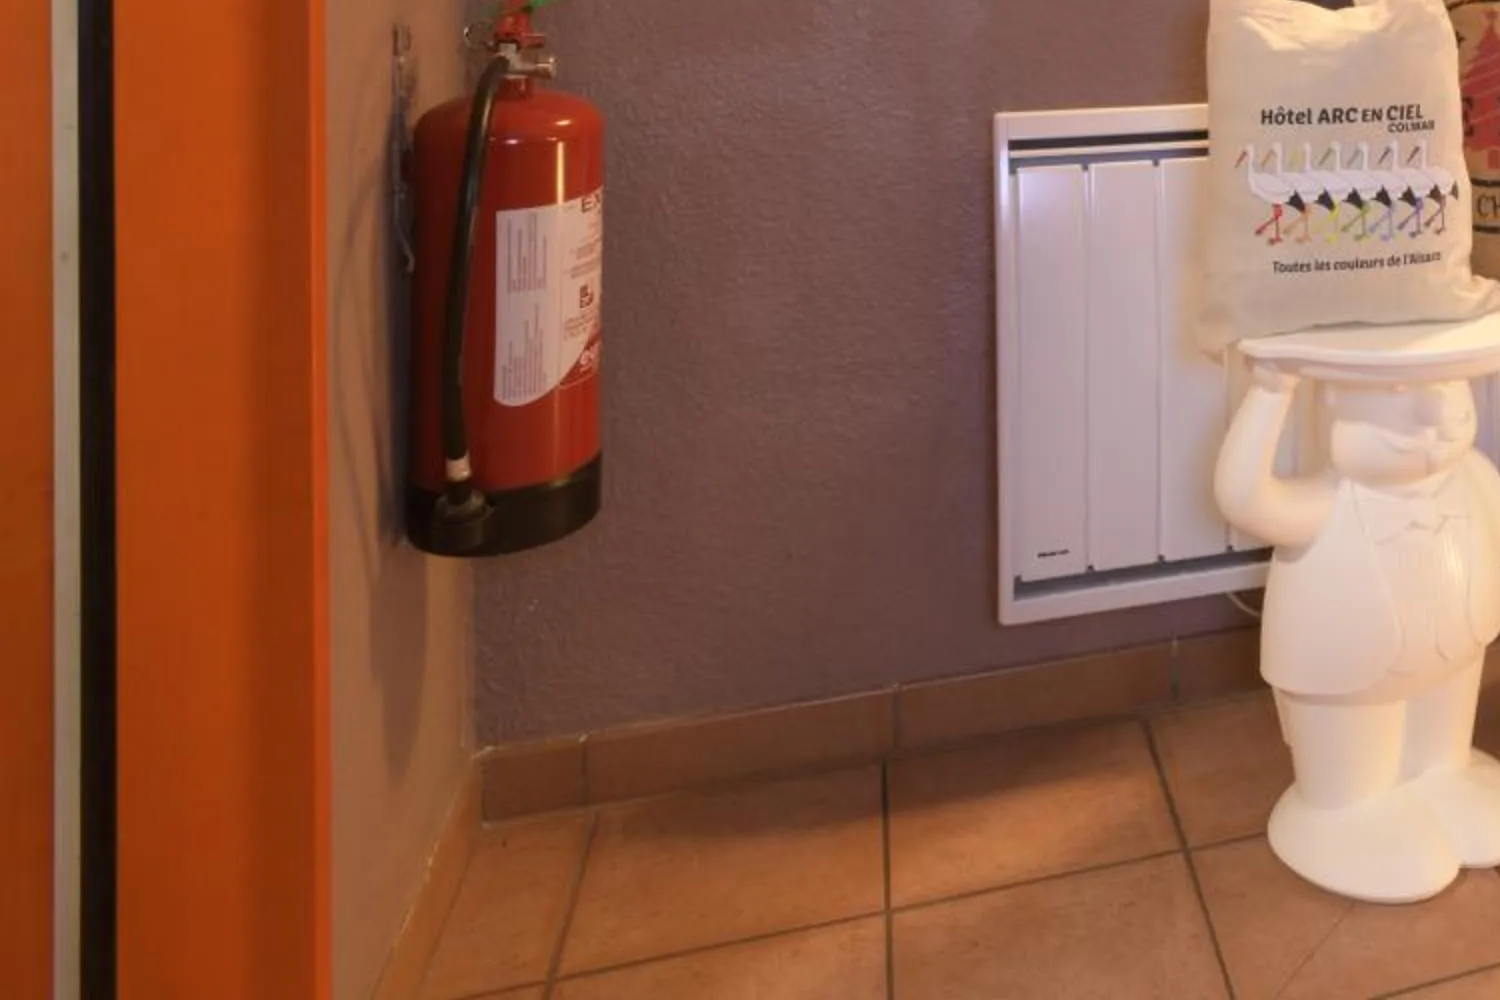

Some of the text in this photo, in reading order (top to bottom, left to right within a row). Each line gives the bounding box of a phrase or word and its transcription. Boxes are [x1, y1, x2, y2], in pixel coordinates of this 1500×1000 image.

[1260, 103, 1424, 126] Hôtel ARC EN CIEL
[1387, 120, 1436, 133] COLMAR
[1272, 260, 1312, 274] Toutes
[1314, 259, 1330, 271] les
[1333, 257, 1385, 272] couleurs
[1387, 254, 1400, 267] de
